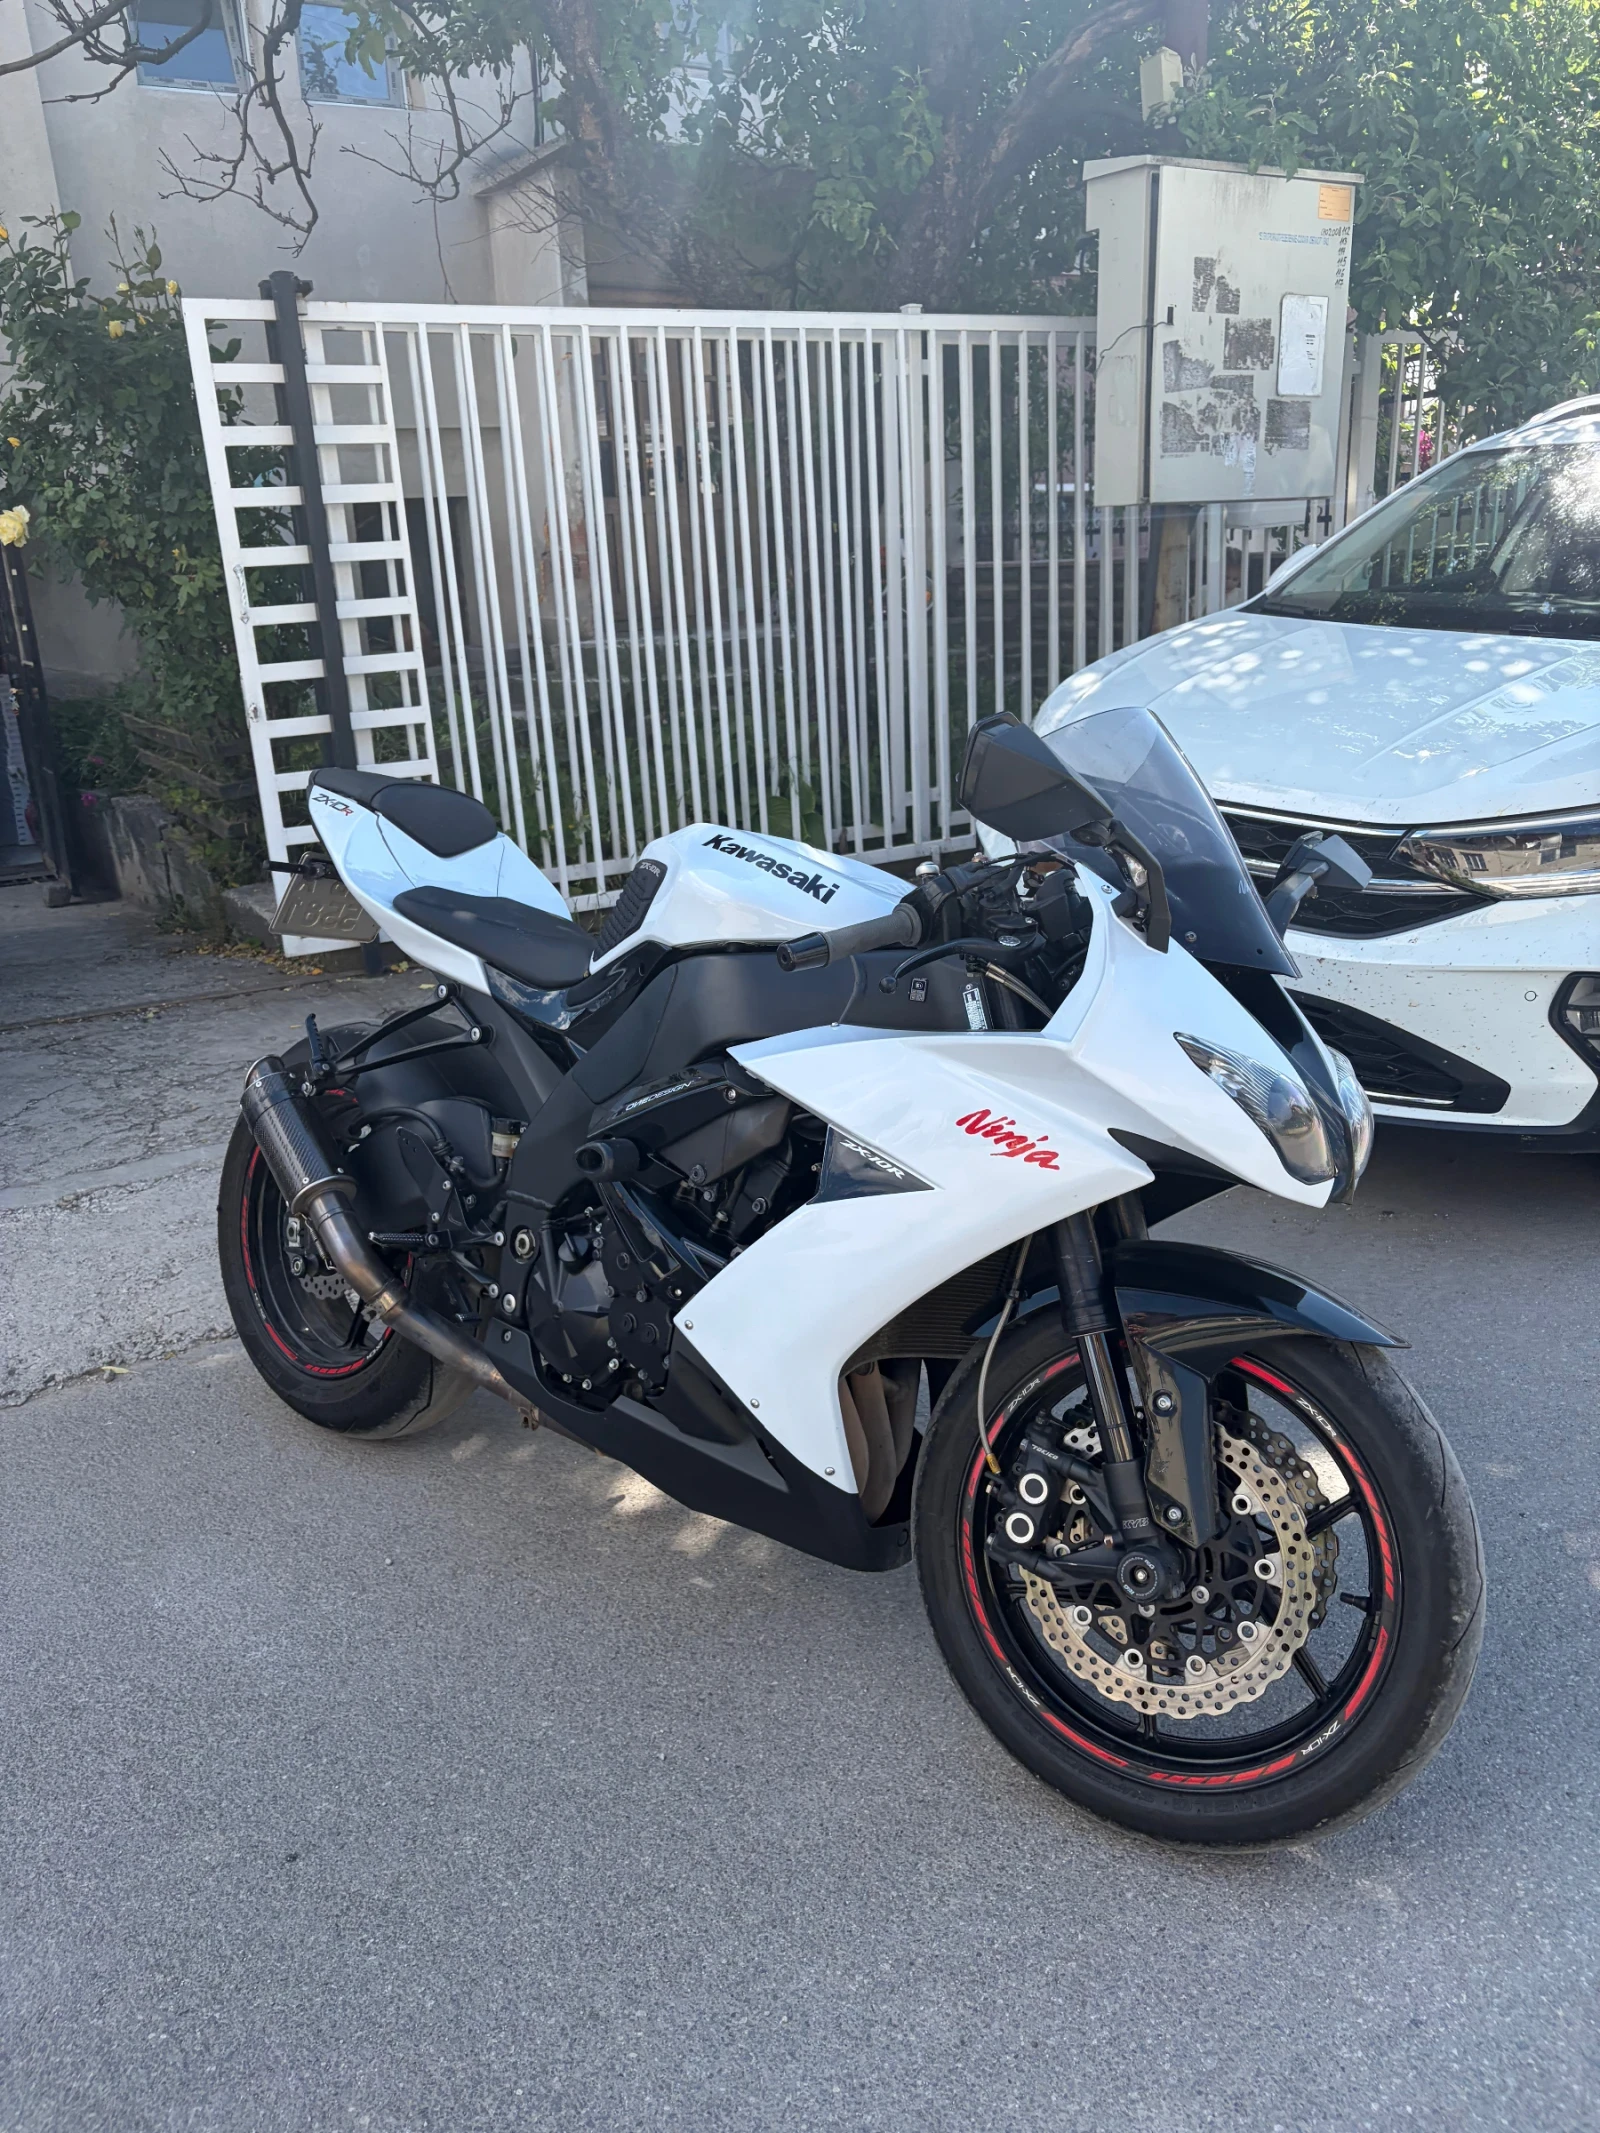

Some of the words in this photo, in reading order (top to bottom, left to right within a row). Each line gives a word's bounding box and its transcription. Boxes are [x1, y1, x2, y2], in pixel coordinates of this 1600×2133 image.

[311, 793, 354, 816] ZX-10R
[701, 834, 840, 905] Kawasaki
[956, 1108, 1060, 1170] Ninja
[839, 1139, 906, 1180] ZX-10R
[1007, 1378, 1040, 1412] ZX-10R
[1296, 1397, 1337, 1437] ZX-10R
[1006, 1665, 1041, 1708] ZX-10R
[1301, 1720, 1341, 1755] ZX-10R
